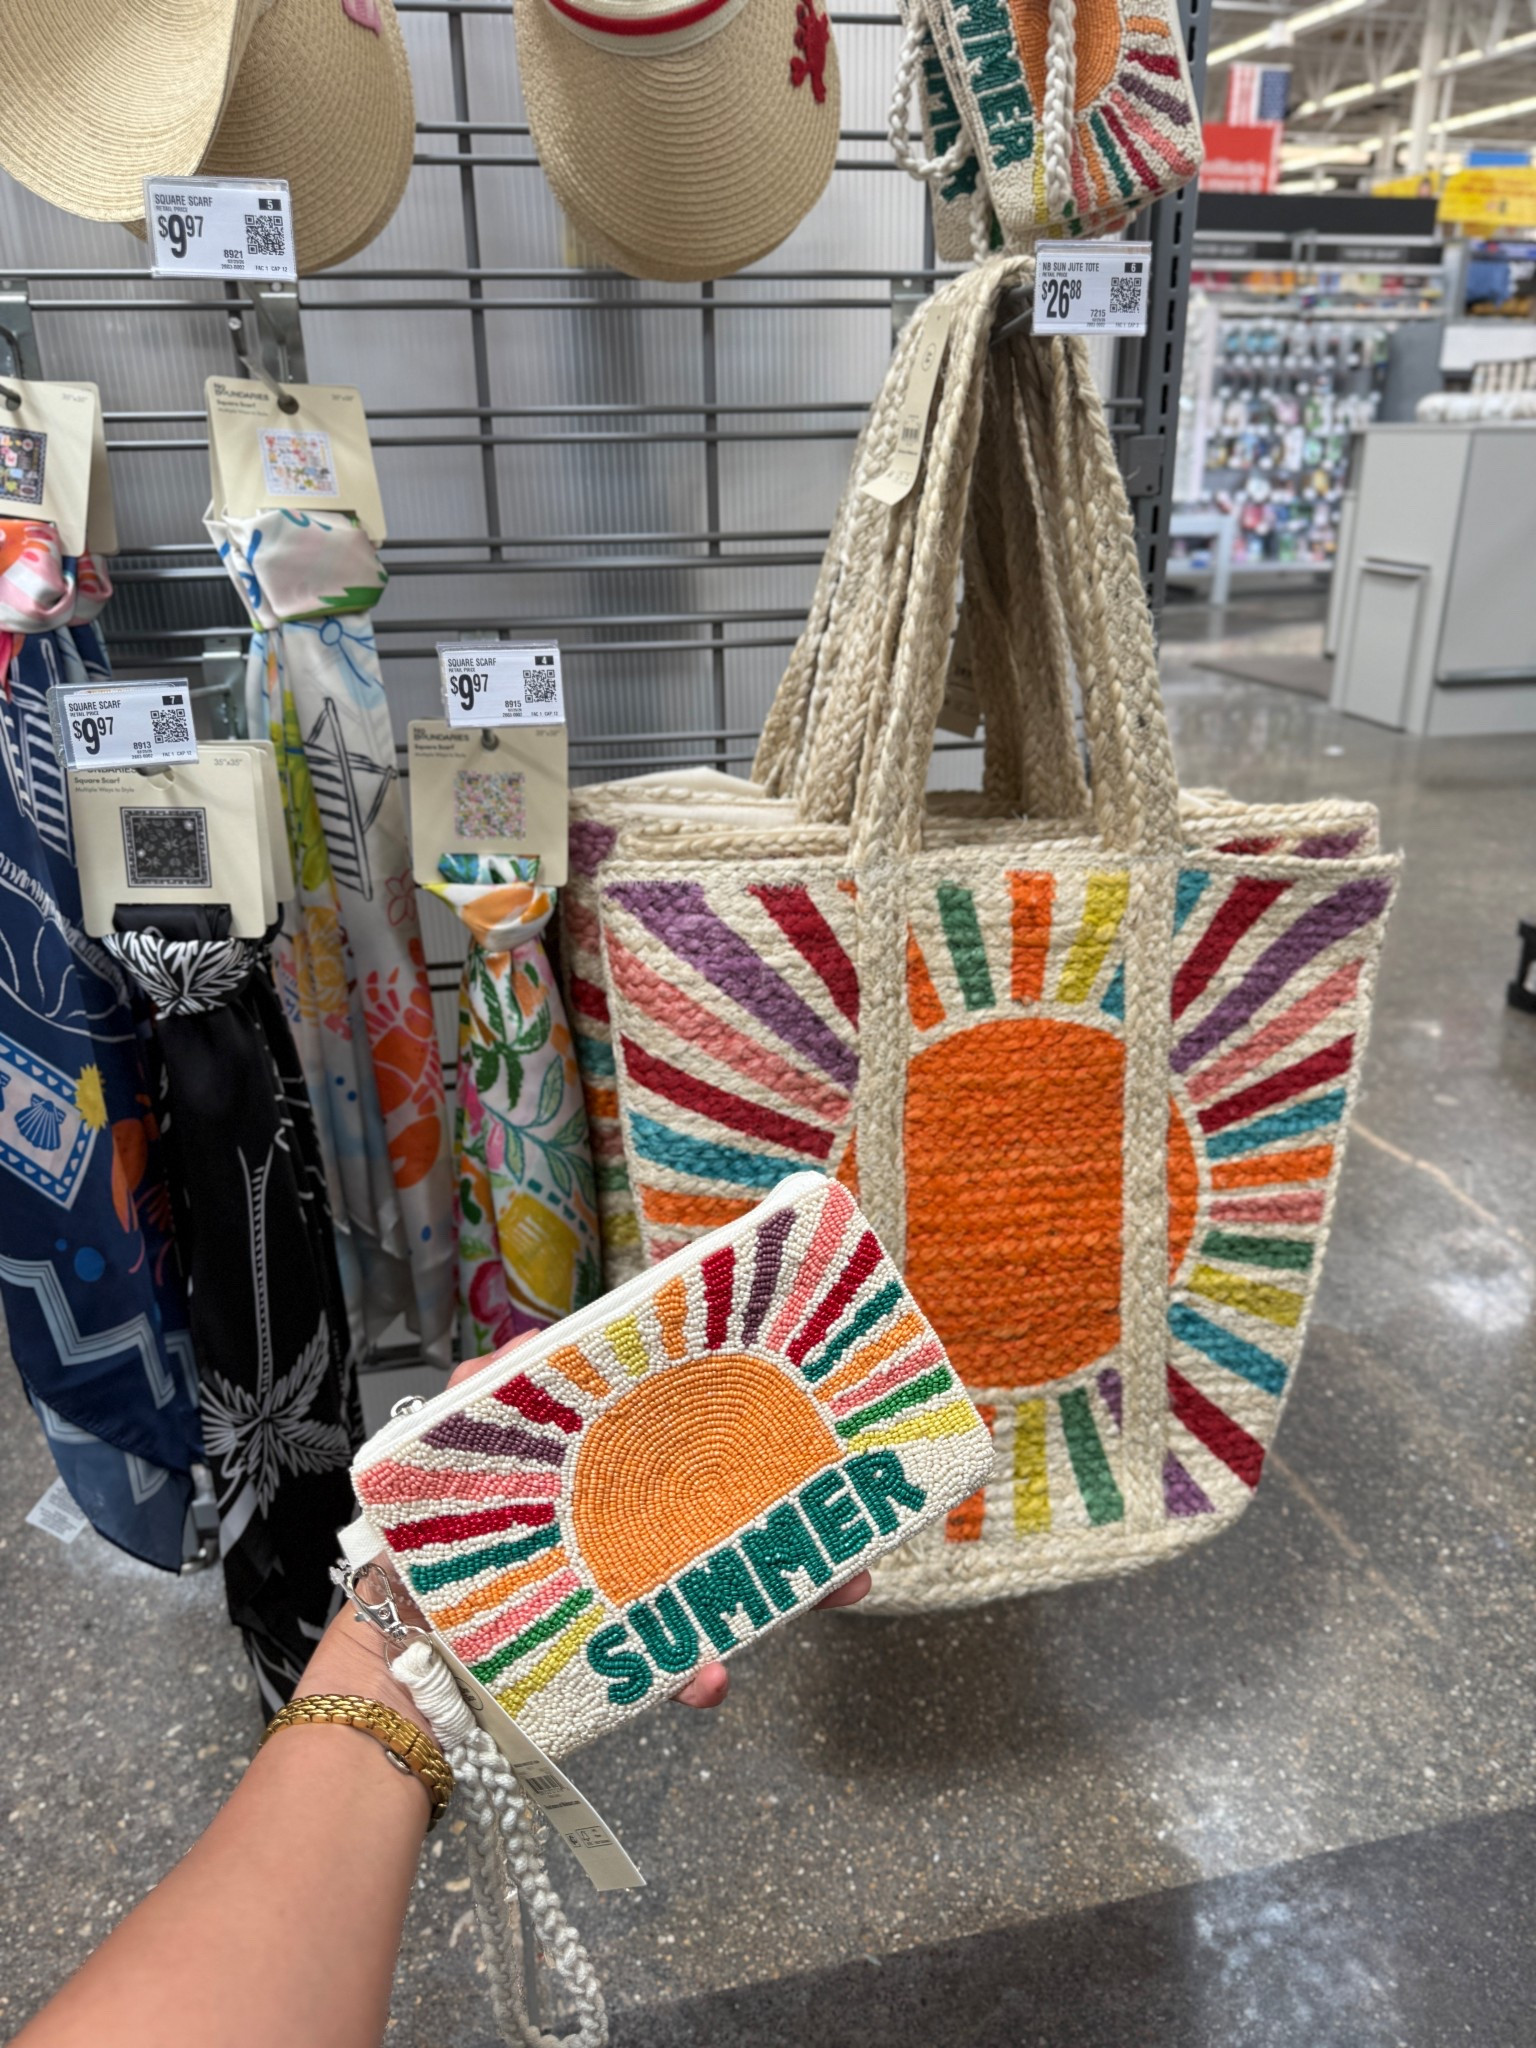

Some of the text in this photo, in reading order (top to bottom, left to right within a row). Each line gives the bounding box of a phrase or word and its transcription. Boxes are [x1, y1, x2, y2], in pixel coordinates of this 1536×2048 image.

[951, 0, 1034, 171] MMER
[154, 194, 213, 208] SQUARE SCARF
[267, 200, 274, 210] 5
[223, 249, 244, 259] 8921
[1042, 262, 1099, 272] NB SUN JUTE TOTE
[1131, 263, 1136, 272] 6
[1090, 309, 1106, 318] 7215
[448, 657, 497, 668] SQUARE SCARF
[169, 696, 176, 704] 7
[504, 700, 522, 708] 8915
[68, 699, 122, 712] SQUARE SCARF
[133, 741, 152, 750] 8913
[74, 777, 100, 785] Square
[586, 1449, 928, 1706] SUMMER
